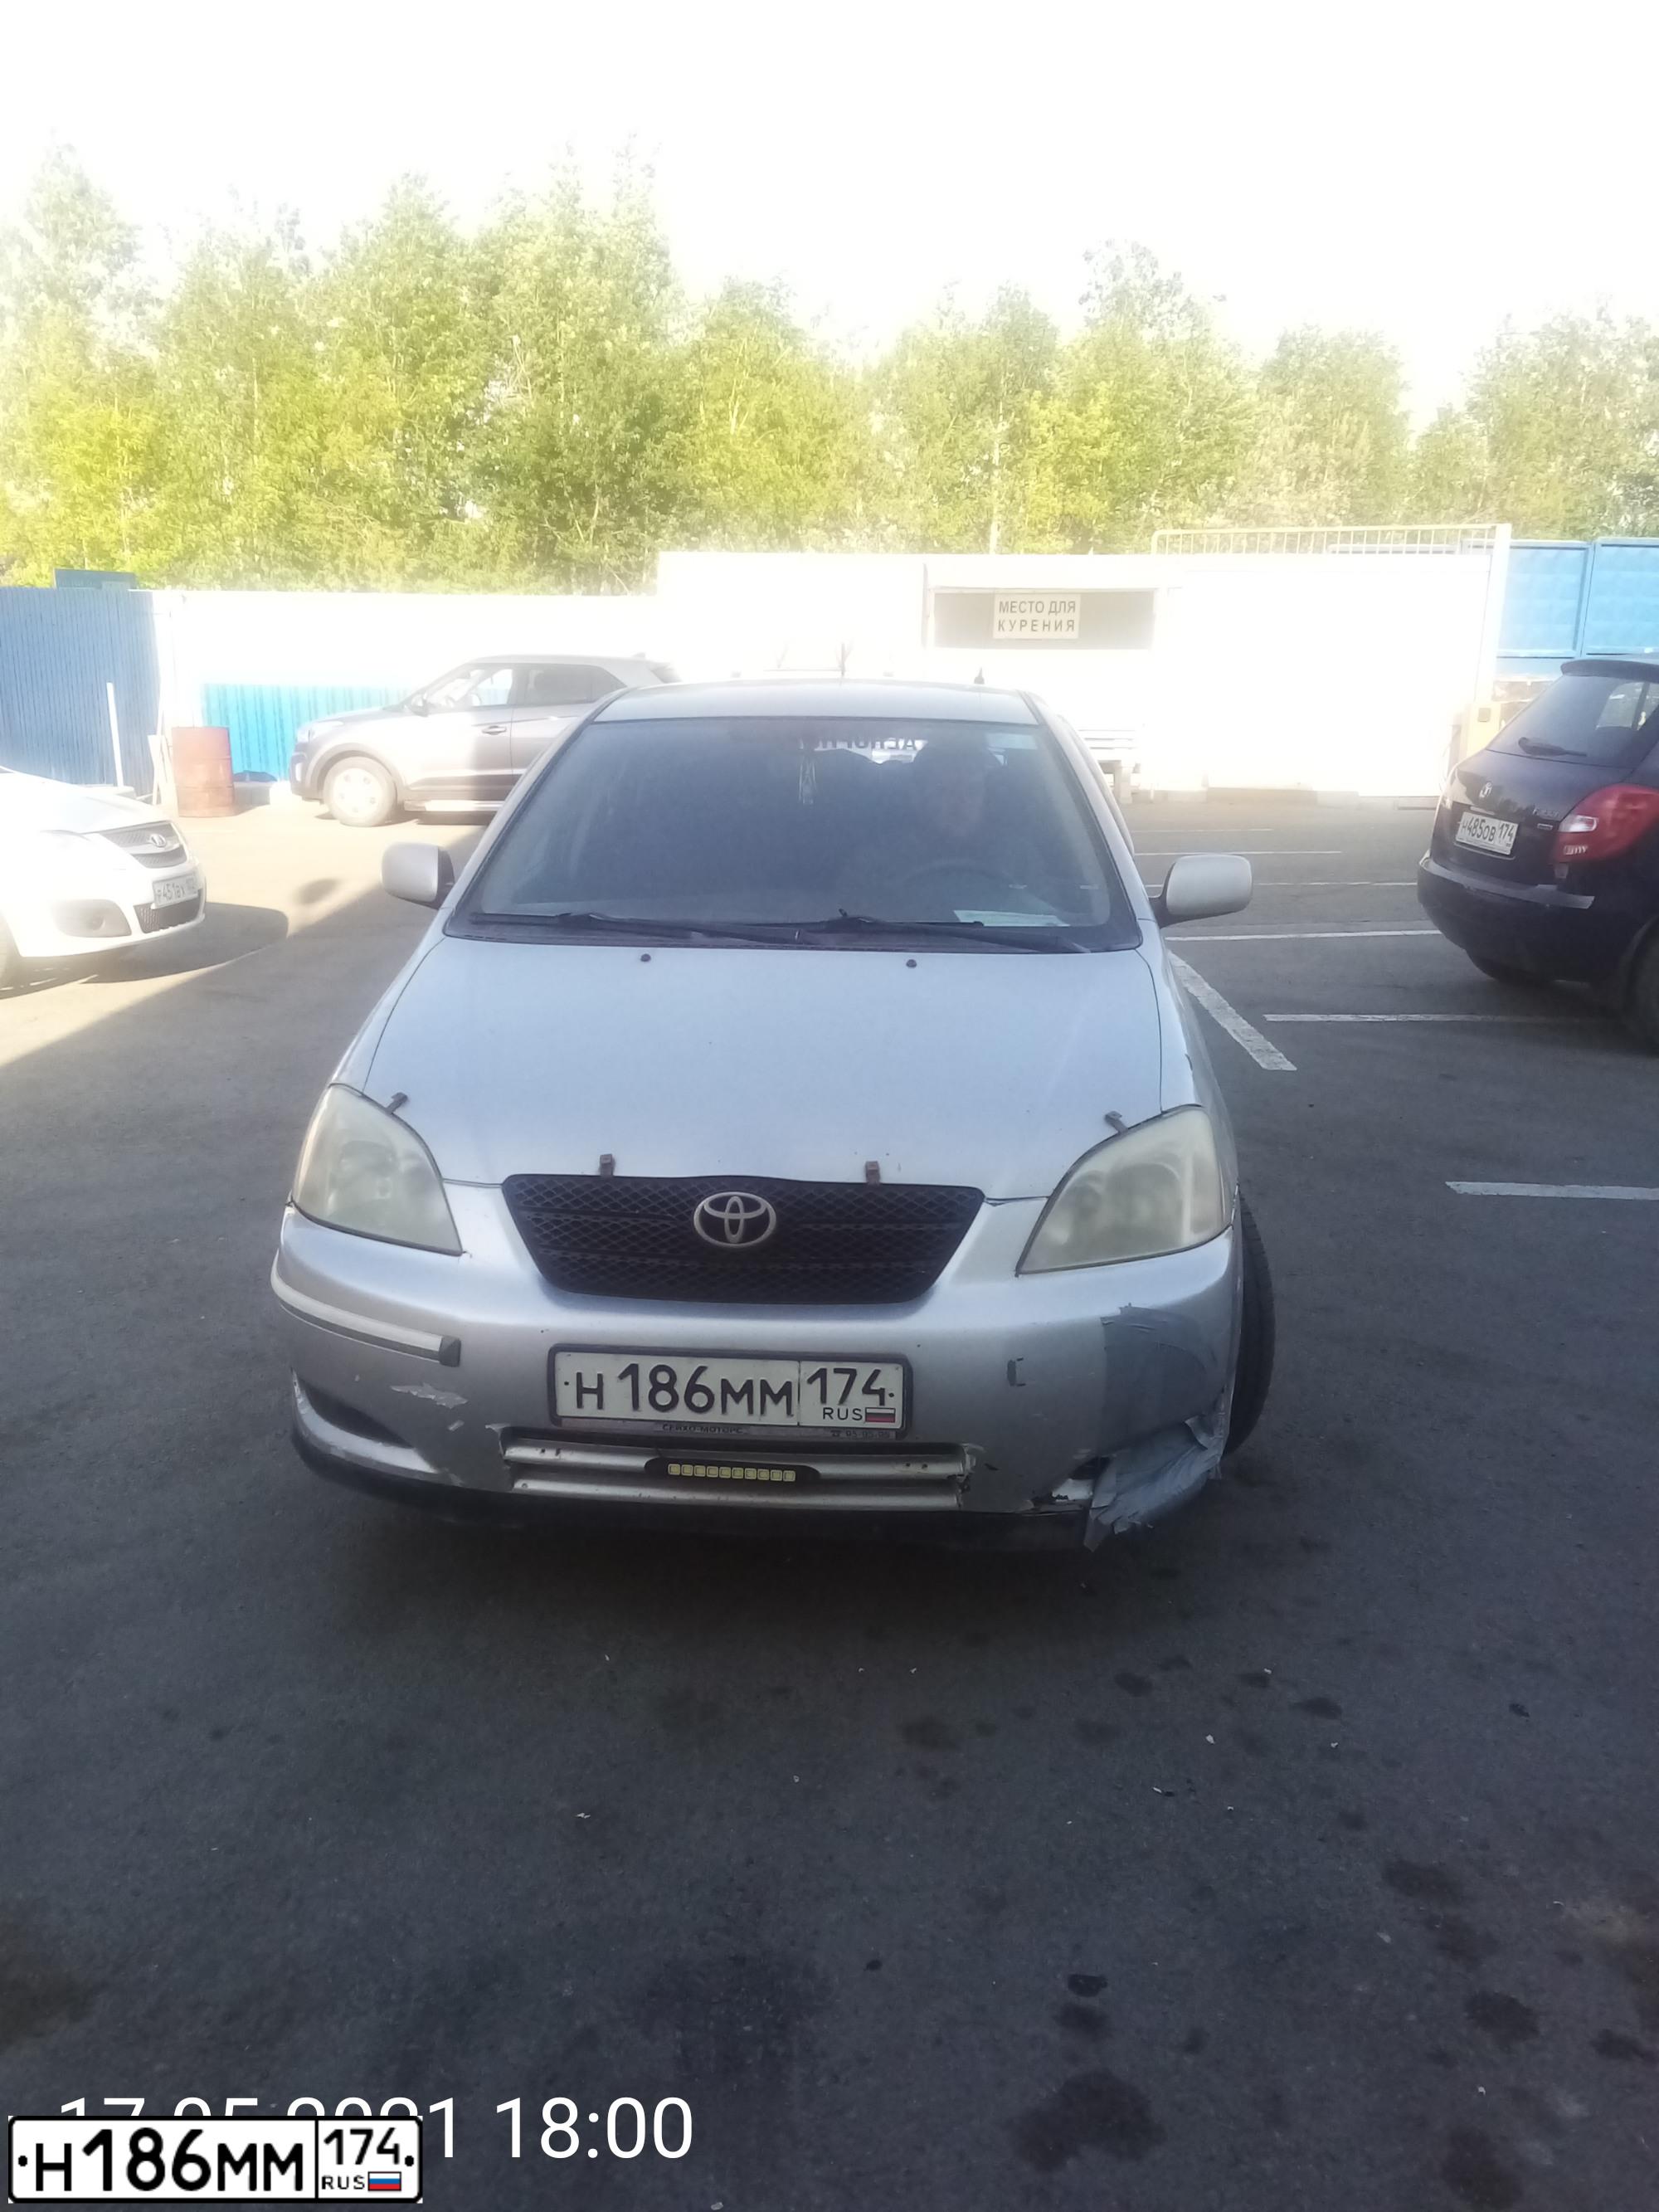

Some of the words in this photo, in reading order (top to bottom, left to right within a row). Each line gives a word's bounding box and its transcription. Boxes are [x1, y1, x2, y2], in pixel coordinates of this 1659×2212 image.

[999, 601, 1044, 613] МЕСТО
[1048, 601, 1076, 615] ДЛЯ
[998, 620, 1074, 631] КУРЕНИЯ
[576, 1363, 793, 1416] Н186ММ
[807, 1367, 886, 1406] 174
[823, 1407, 863, 1420] RUS
